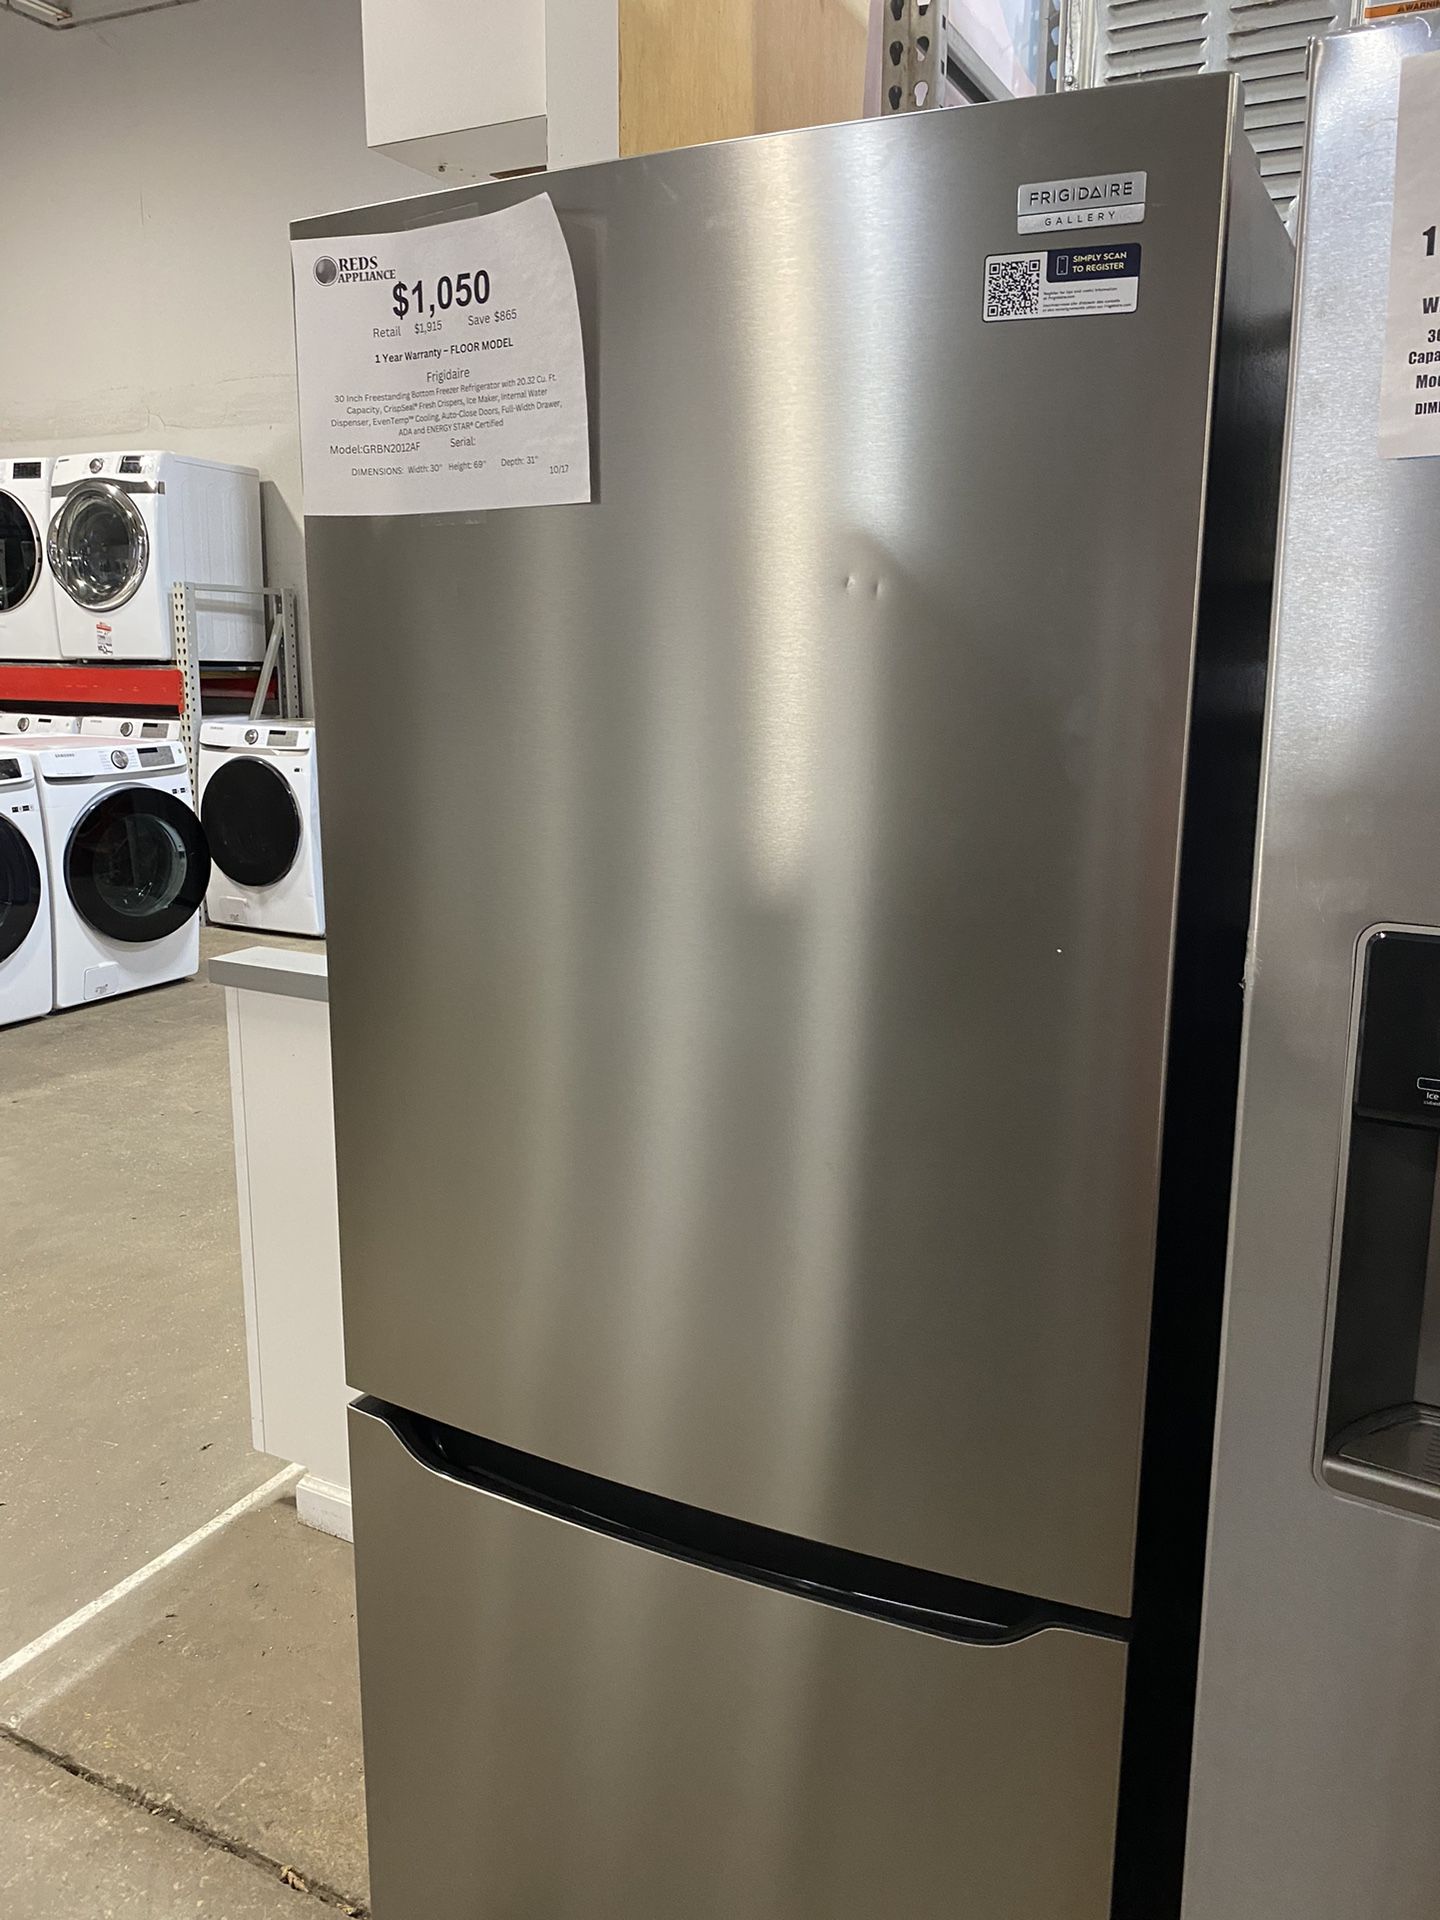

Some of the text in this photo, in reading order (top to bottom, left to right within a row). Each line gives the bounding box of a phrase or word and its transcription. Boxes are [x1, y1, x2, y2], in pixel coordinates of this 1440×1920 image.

[1029, 181, 1133, 206] FRIGIDAIRE
[1044, 211, 1115, 226] GALLERY
[338, 255, 378, 272] REDS
[1072, 251, 1127, 263] SIMPLY SCAN
[338, 269, 396, 284] APPLIANCE
[1072, 262, 1125, 273] TO REGISTER
[392, 269, 491, 321] $1,050
[1422, 296, 1440, 314] W
[372, 308, 518, 339] Retail $1,915 Save $865
[375, 354, 381, 364] 1
[382, 351, 403, 363] Year
[404, 348, 442, 361] Warranty
[450, 341, 481, 355] FLOOR
[482, 337, 514, 351] MODEL
[426, 367, 471, 384] Frigidaire
[334, 394, 345, 403] 30
[346, 393, 363, 402] Inch
[364, 391, 411, 402] Freestanding
[411, 388, 435, 399] Bottom
[435, 385, 460, 395] Freezer
[460, 381, 501, 393] Refrigerator
[501, 378, 516, 388] with
[516, 376, 536, 386] 20.32
[346, 405, 382, 416] Capacity,
[418, 400, 437, 409] Fresh
[437, 397, 465, 408] Crispers,
[466, 396, 477, 405] Ice
[478, 394, 500, 403] Maker,
[501, 389, 527, 400] Internal
[528, 387, 548, 397] Water
[331, 417, 372, 428] Dispenser,
[415, 411, 440, 422] Cooling,
[441, 407, 477, 420] Auto-Close
[478, 405, 500, 416] Doors,
[501, 400, 535, 414] Full-Width
[536, 398, 563, 409] Drawer,
[398, 427, 413, 436] ADA
[413, 425, 425, 435] and
[426, 422, 452, 434] ENERGY
[474, 417, 504, 429] Certified
[329, 436, 476, 455] Model:GRBN2012AF Serial:
[351, 465, 404, 477] DIMENSIONS:
[448, 460, 471, 473] Height:
[500, 456, 525, 468] Depth:
[549, 463, 570, 475] 10/17
[1426, 1091, 1440, 1101] Ice
